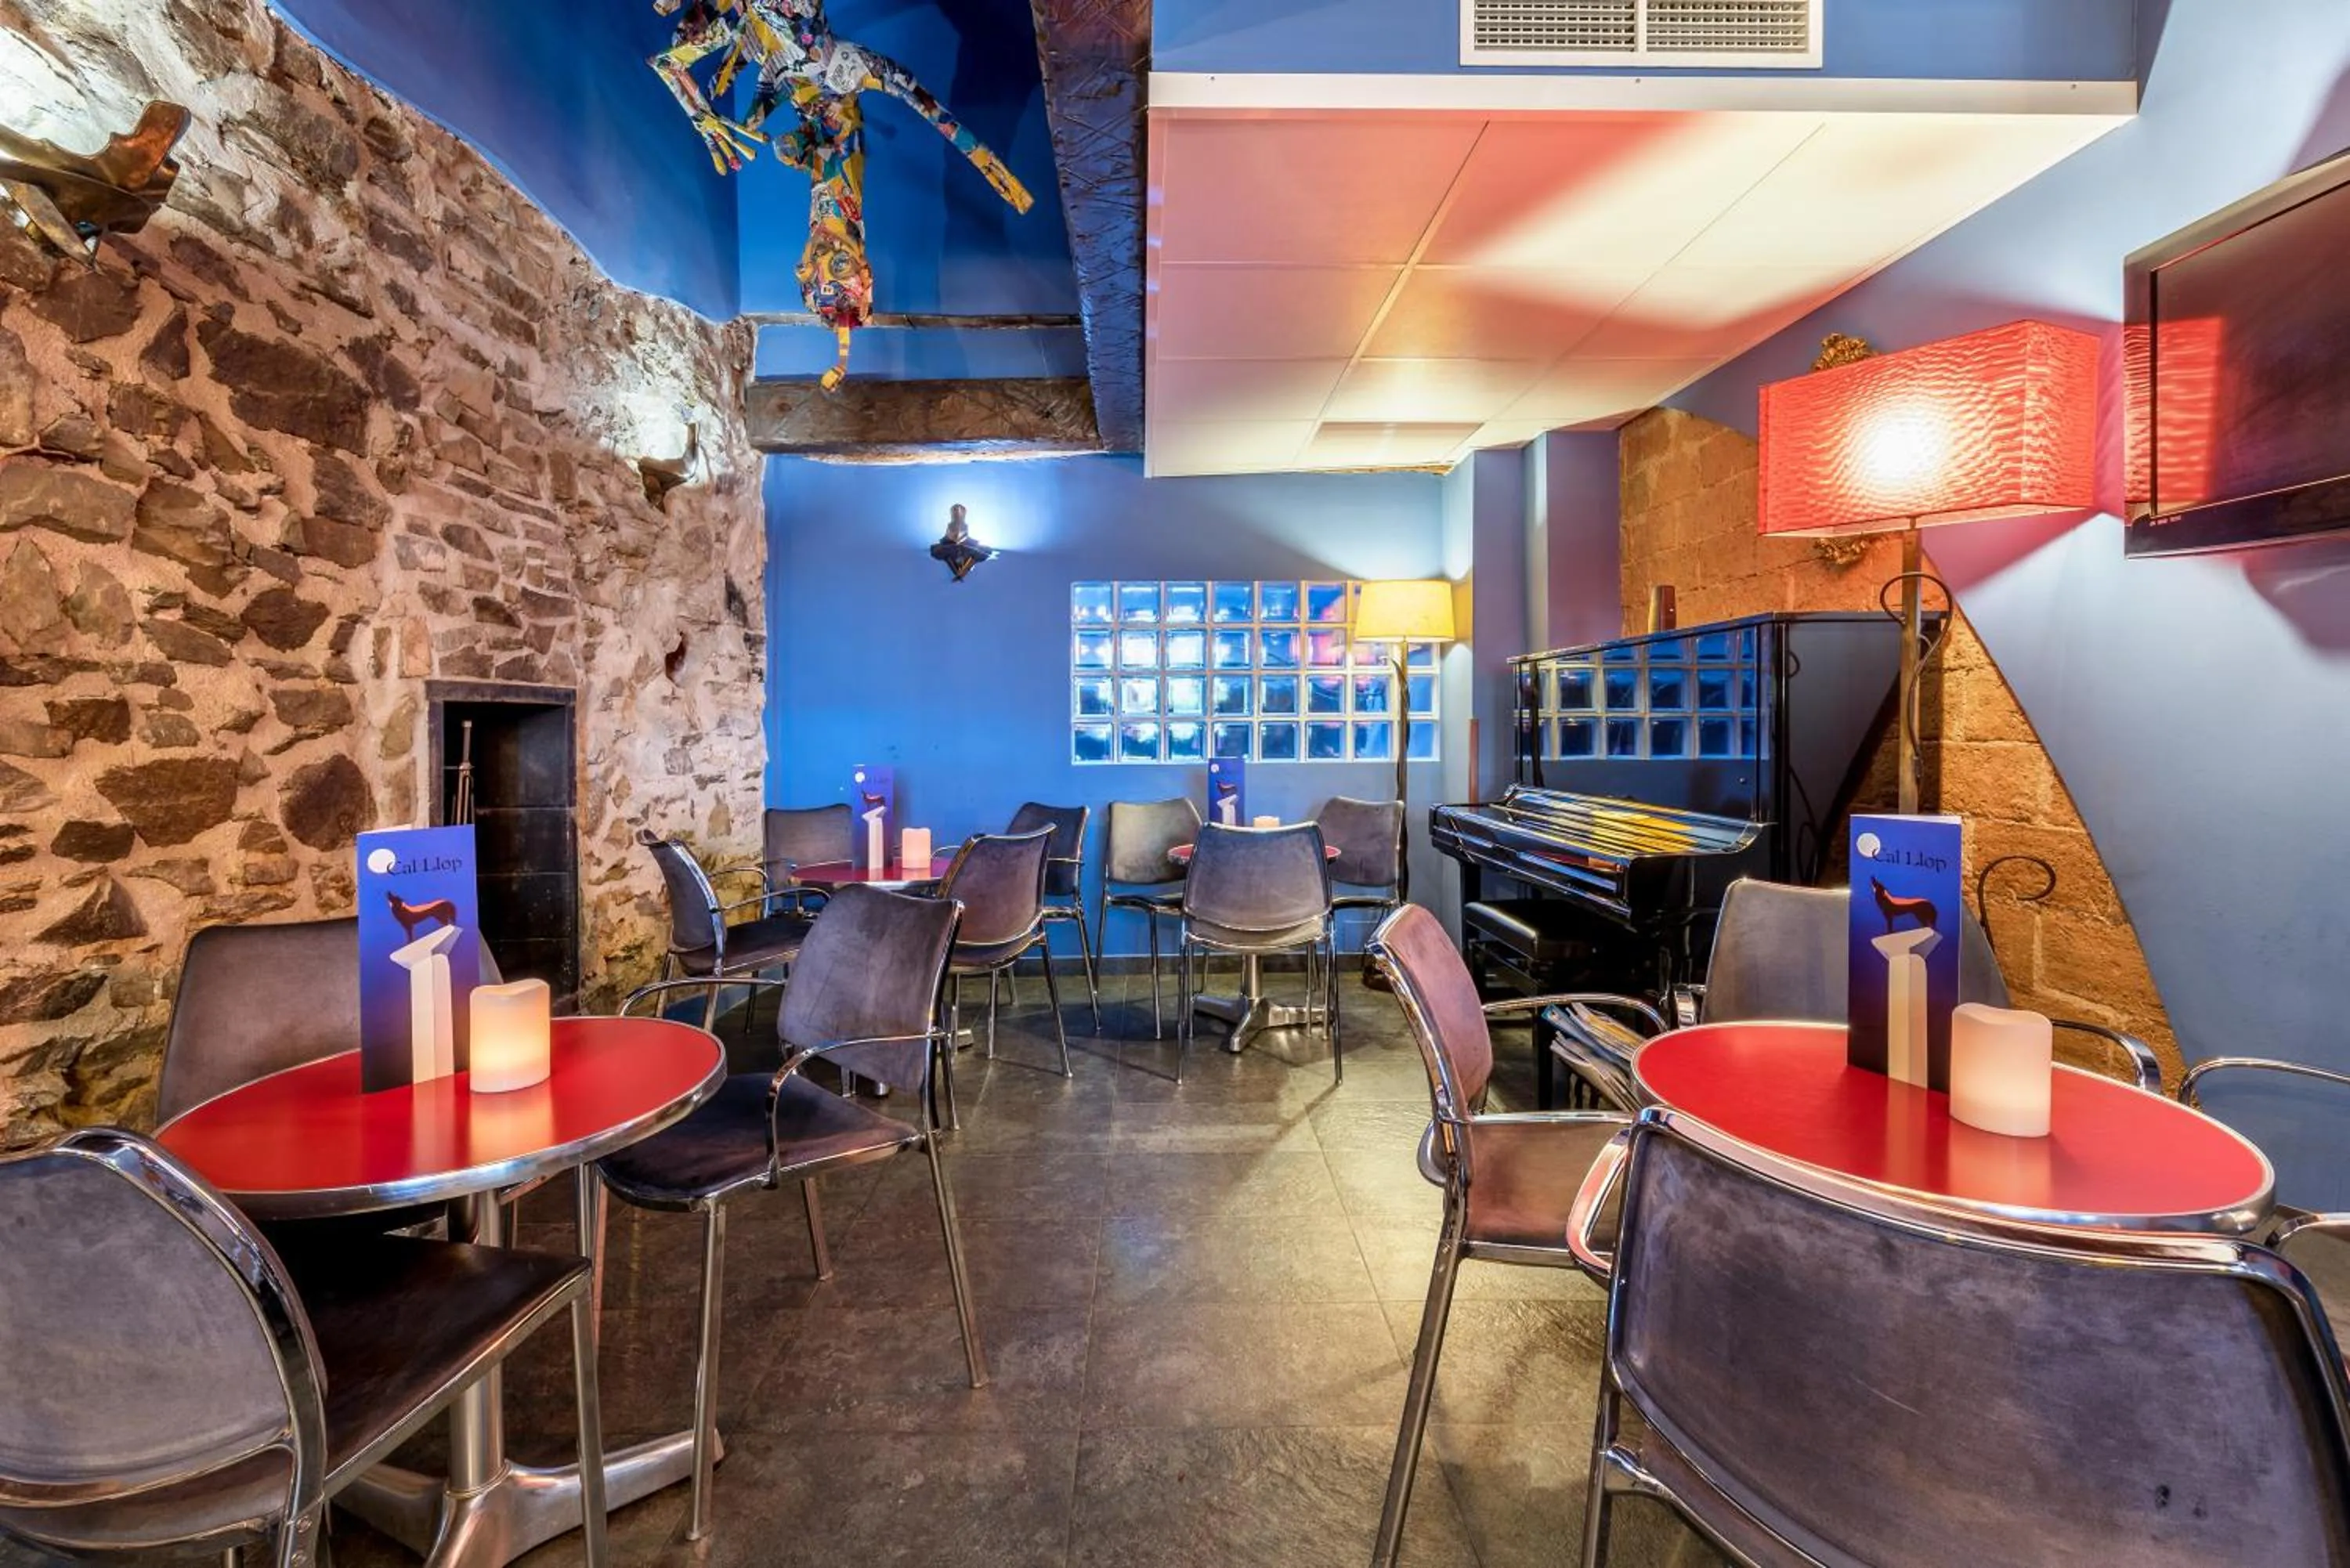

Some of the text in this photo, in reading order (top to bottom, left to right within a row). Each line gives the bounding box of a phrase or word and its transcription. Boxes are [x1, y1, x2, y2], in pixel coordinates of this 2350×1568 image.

[387, 857, 462, 876] Cal Llop
[1872, 848, 1947, 873] Cal Llop
